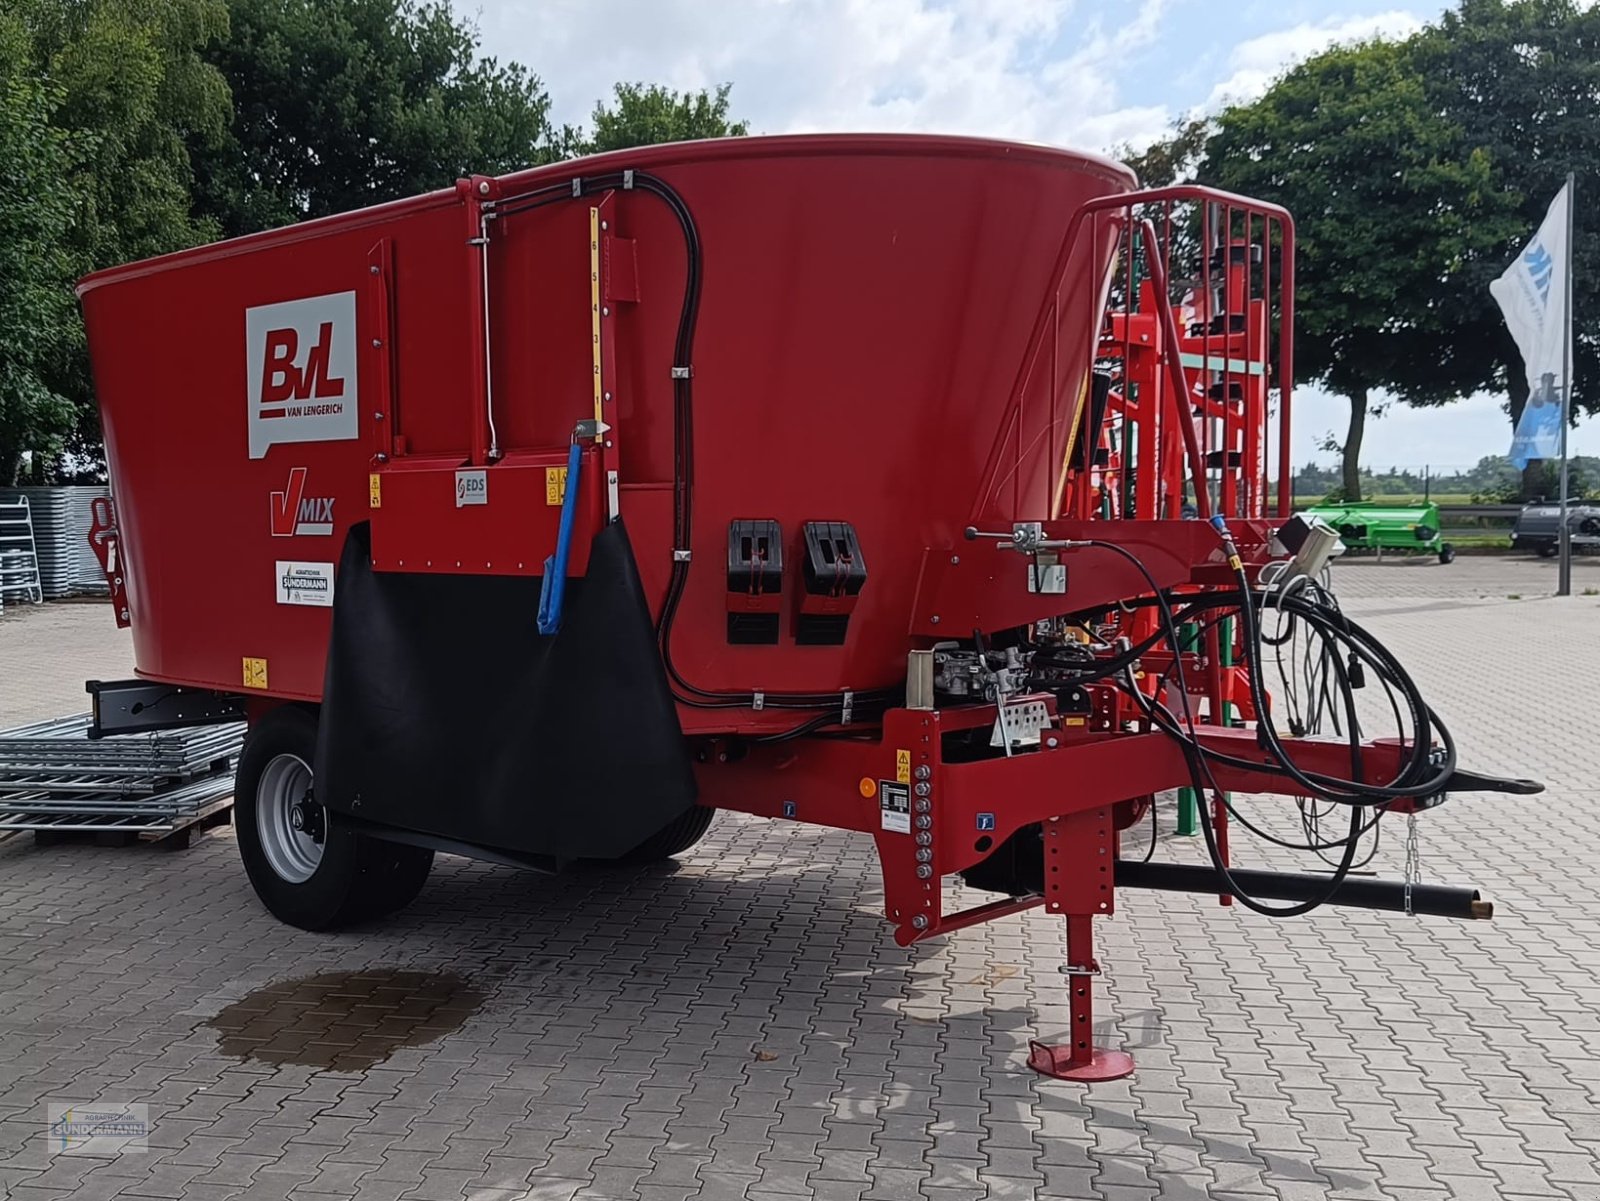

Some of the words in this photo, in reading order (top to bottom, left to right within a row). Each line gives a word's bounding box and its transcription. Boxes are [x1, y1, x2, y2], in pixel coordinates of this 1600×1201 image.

[592, 209, 597, 218] 7
[592, 241, 597, 250] 6
[592, 272, 597, 281] 5
[593, 304, 598, 312] 4
[594, 334, 599, 343] 3
[594, 365, 599, 374] 2
[287, 406, 302, 417] VAN
[303, 403, 343, 416] LENGERICH
[466, 478, 484, 491] EDS
